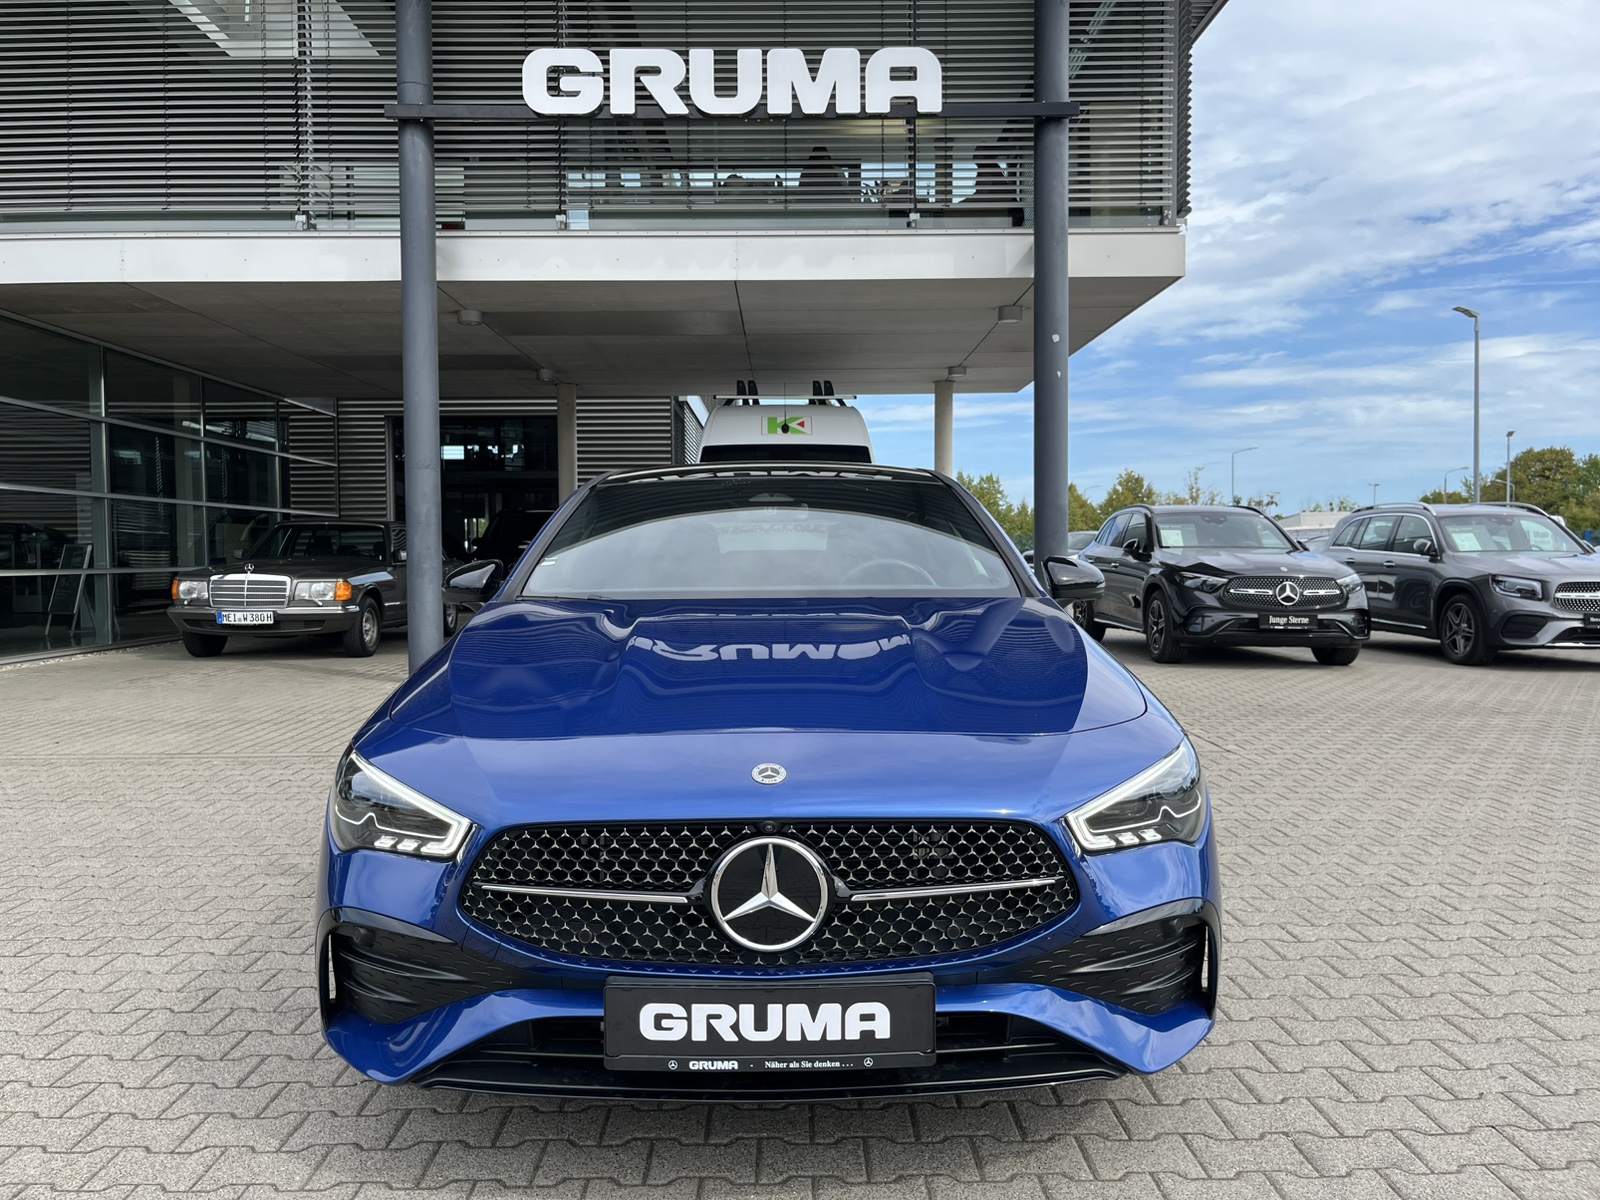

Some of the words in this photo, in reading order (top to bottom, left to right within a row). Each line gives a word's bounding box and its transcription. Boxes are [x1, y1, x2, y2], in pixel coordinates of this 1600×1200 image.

[522, 47, 942, 115] GRUMA
[222, 613, 237, 622] MEI
[1269, 615, 1288, 625] Junge
[1288, 615, 1309, 624] Sterne
[639, 1001, 891, 1042] GRUMA
[688, 1060, 739, 1071] GRUMA
[764, 1060, 788, 1069] Näher
[788, 1060, 800, 1069] als
[800, 1060, 813, 1068] Sie
[813, 1060, 841, 1069] denken
